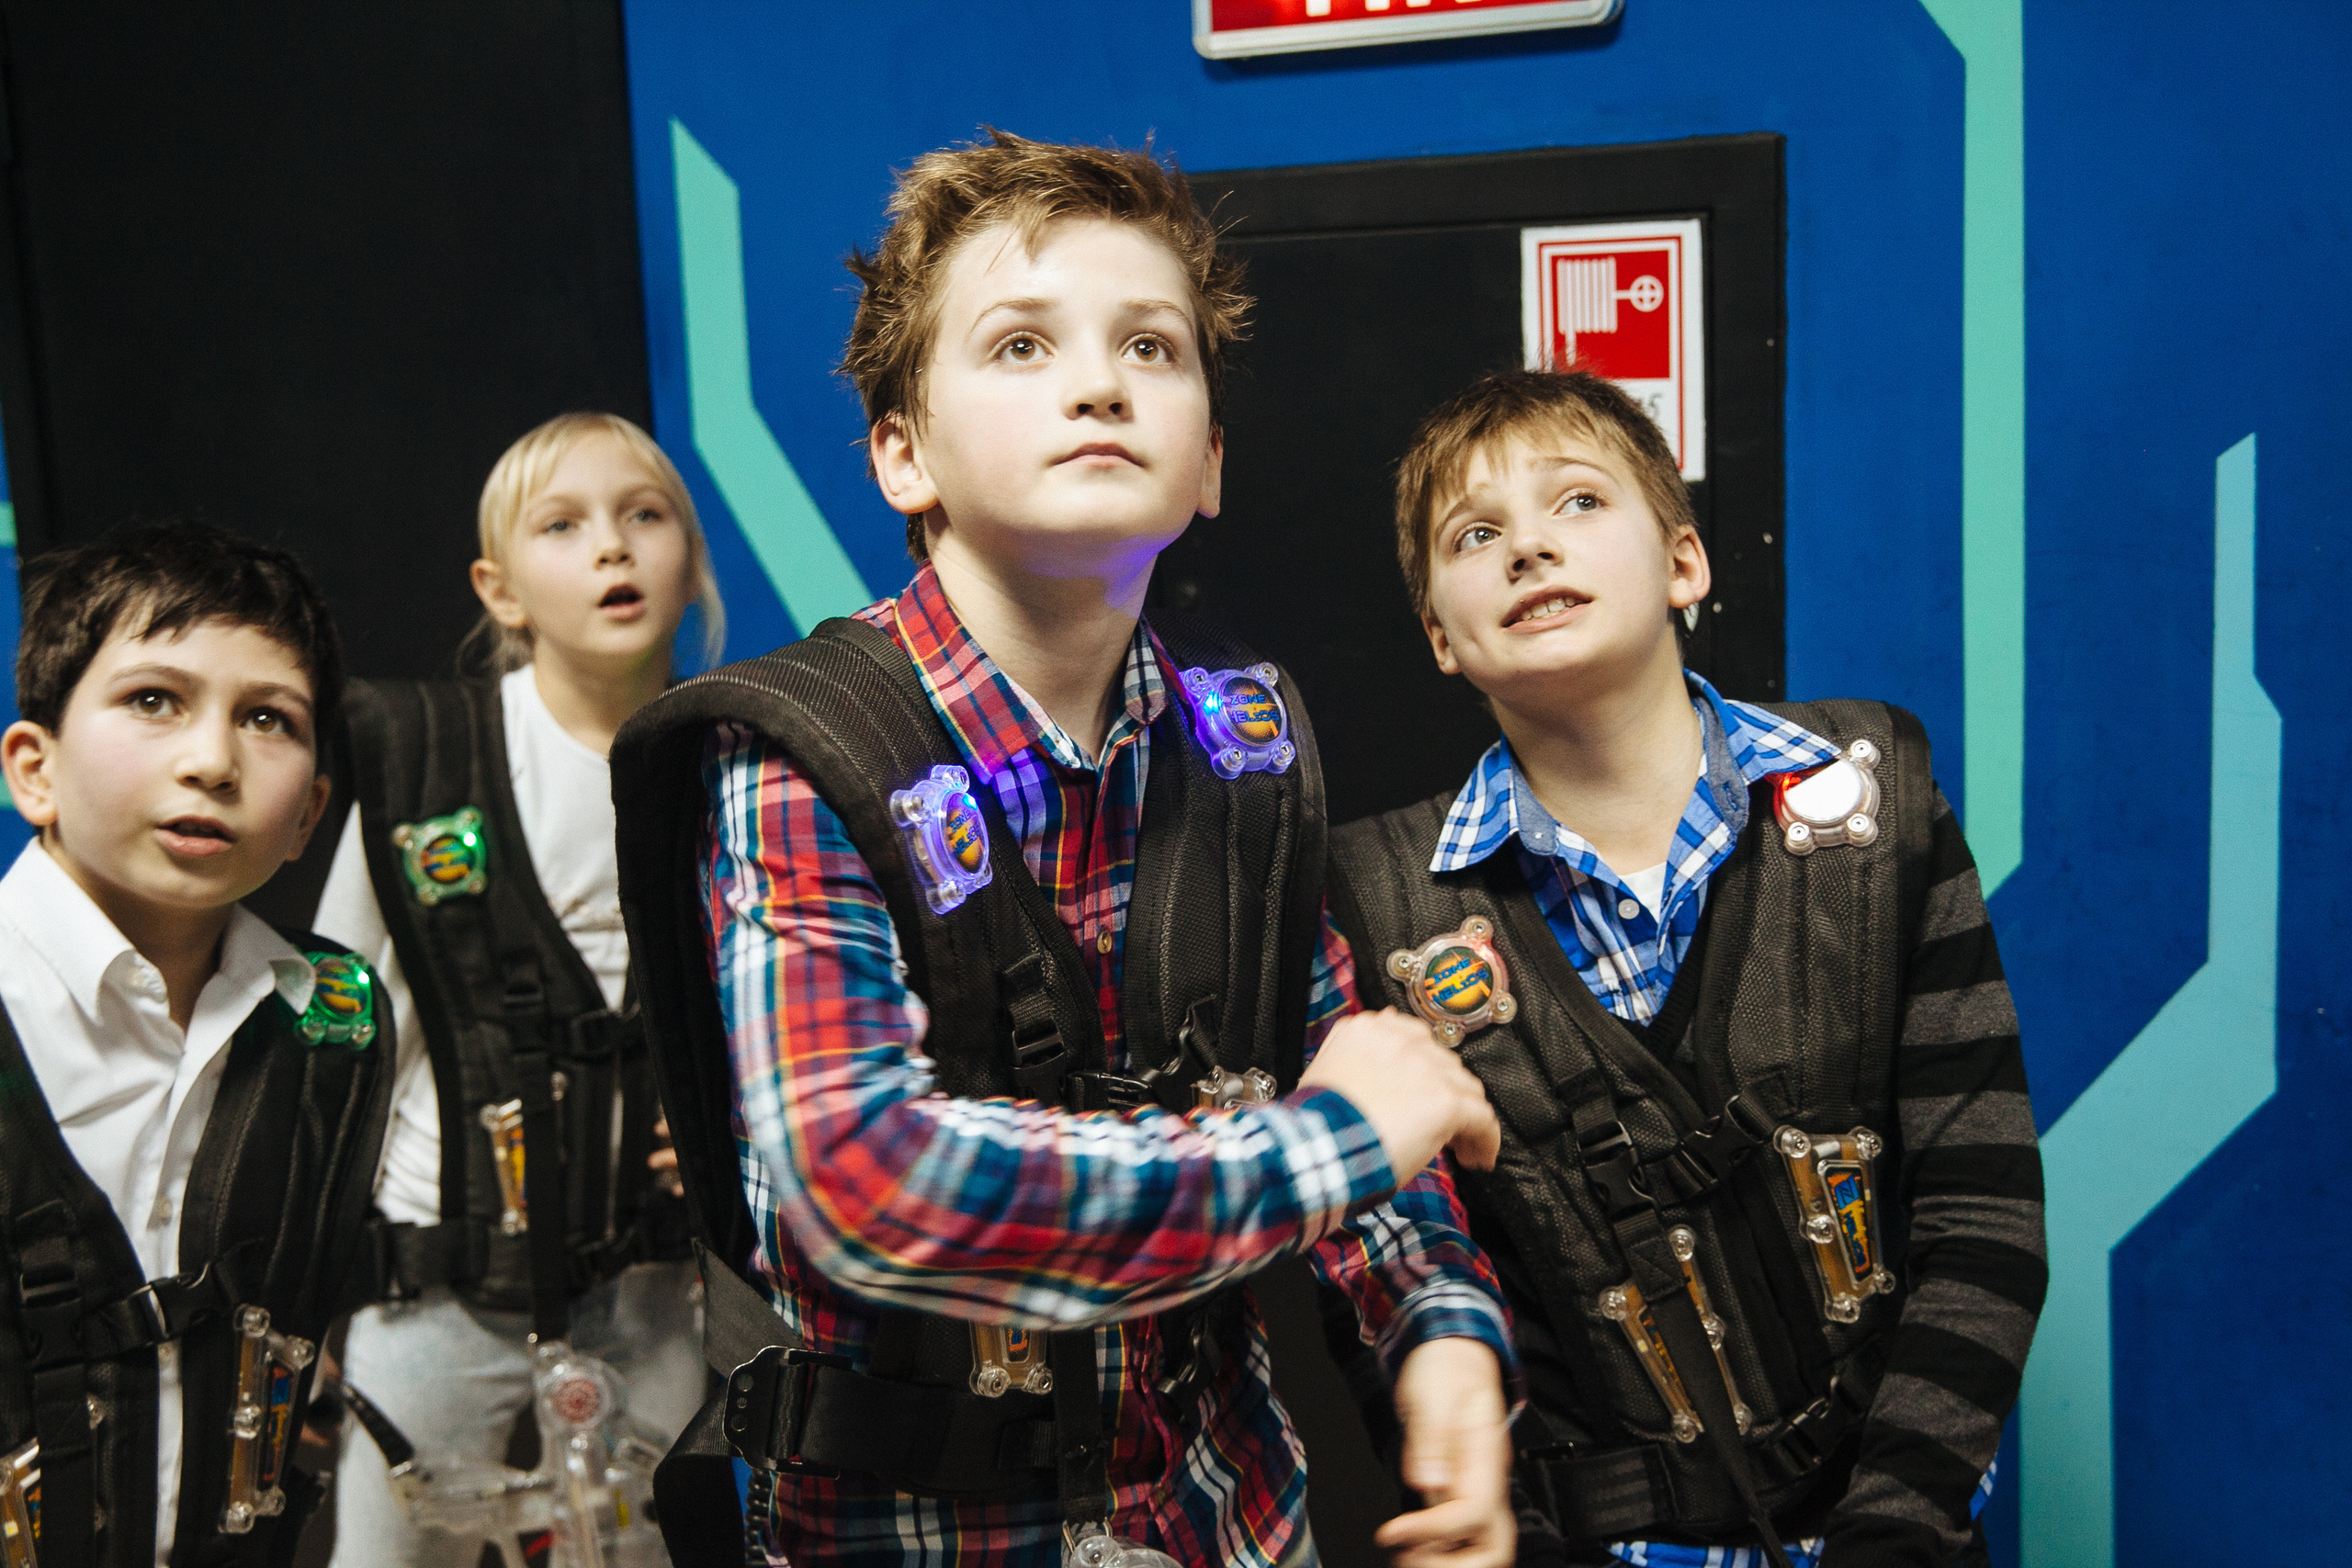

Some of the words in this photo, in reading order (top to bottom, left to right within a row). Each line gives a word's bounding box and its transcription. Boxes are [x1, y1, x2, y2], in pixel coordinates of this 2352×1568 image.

[1229, 694, 1266, 705] ZONE
[949, 810, 972, 834] ZONE
[1432, 957, 1472, 985] ZONE
[1432, 968, 1490, 1004] HELIOS
